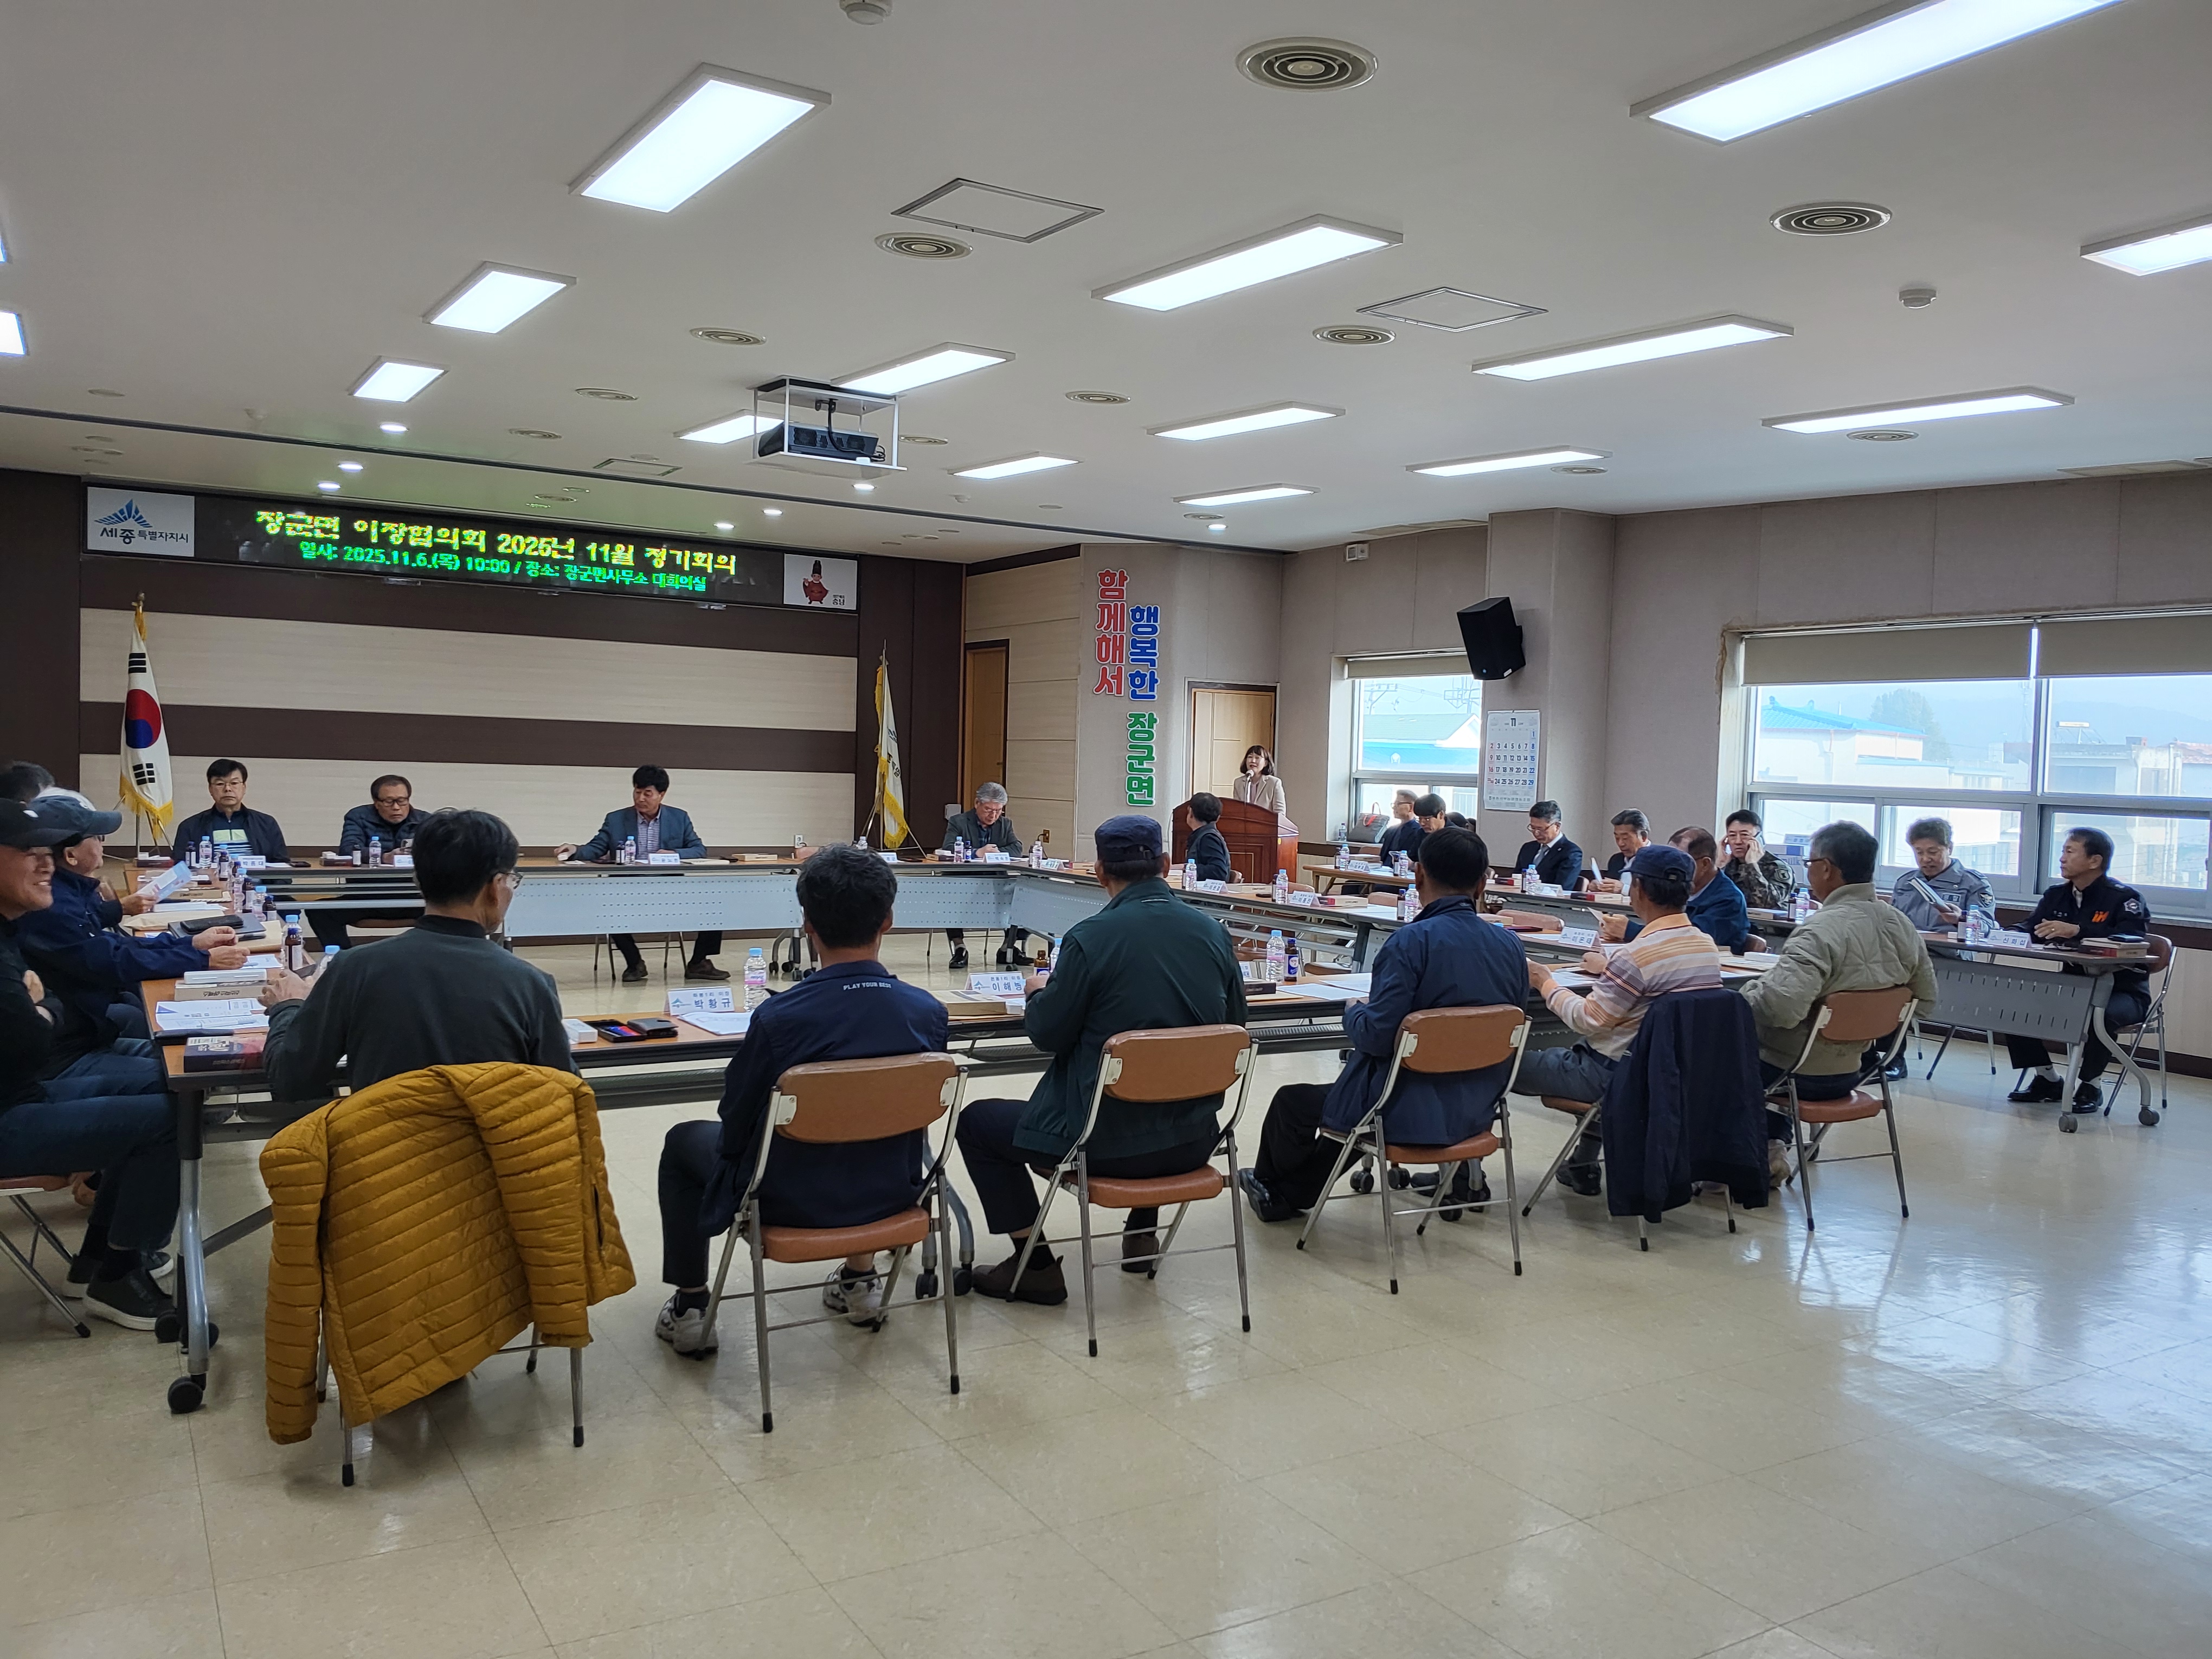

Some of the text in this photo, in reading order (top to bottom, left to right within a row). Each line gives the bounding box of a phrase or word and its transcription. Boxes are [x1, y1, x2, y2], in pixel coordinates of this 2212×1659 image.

[256, 511, 736, 576] 장군면 이장협의회 2025년 11월 정기회의
[465, 556, 511, 574] 10:00
[564, 564, 650, 585] 장군면사무소
[652, 573, 707, 591] 대회의실
[1094, 569, 1129, 696] 함께해서
[1127, 606, 1159, 806] 행복한 장군면
[1510, 718, 1516, 726] 11
[843, 982, 860, 991] PLAY
